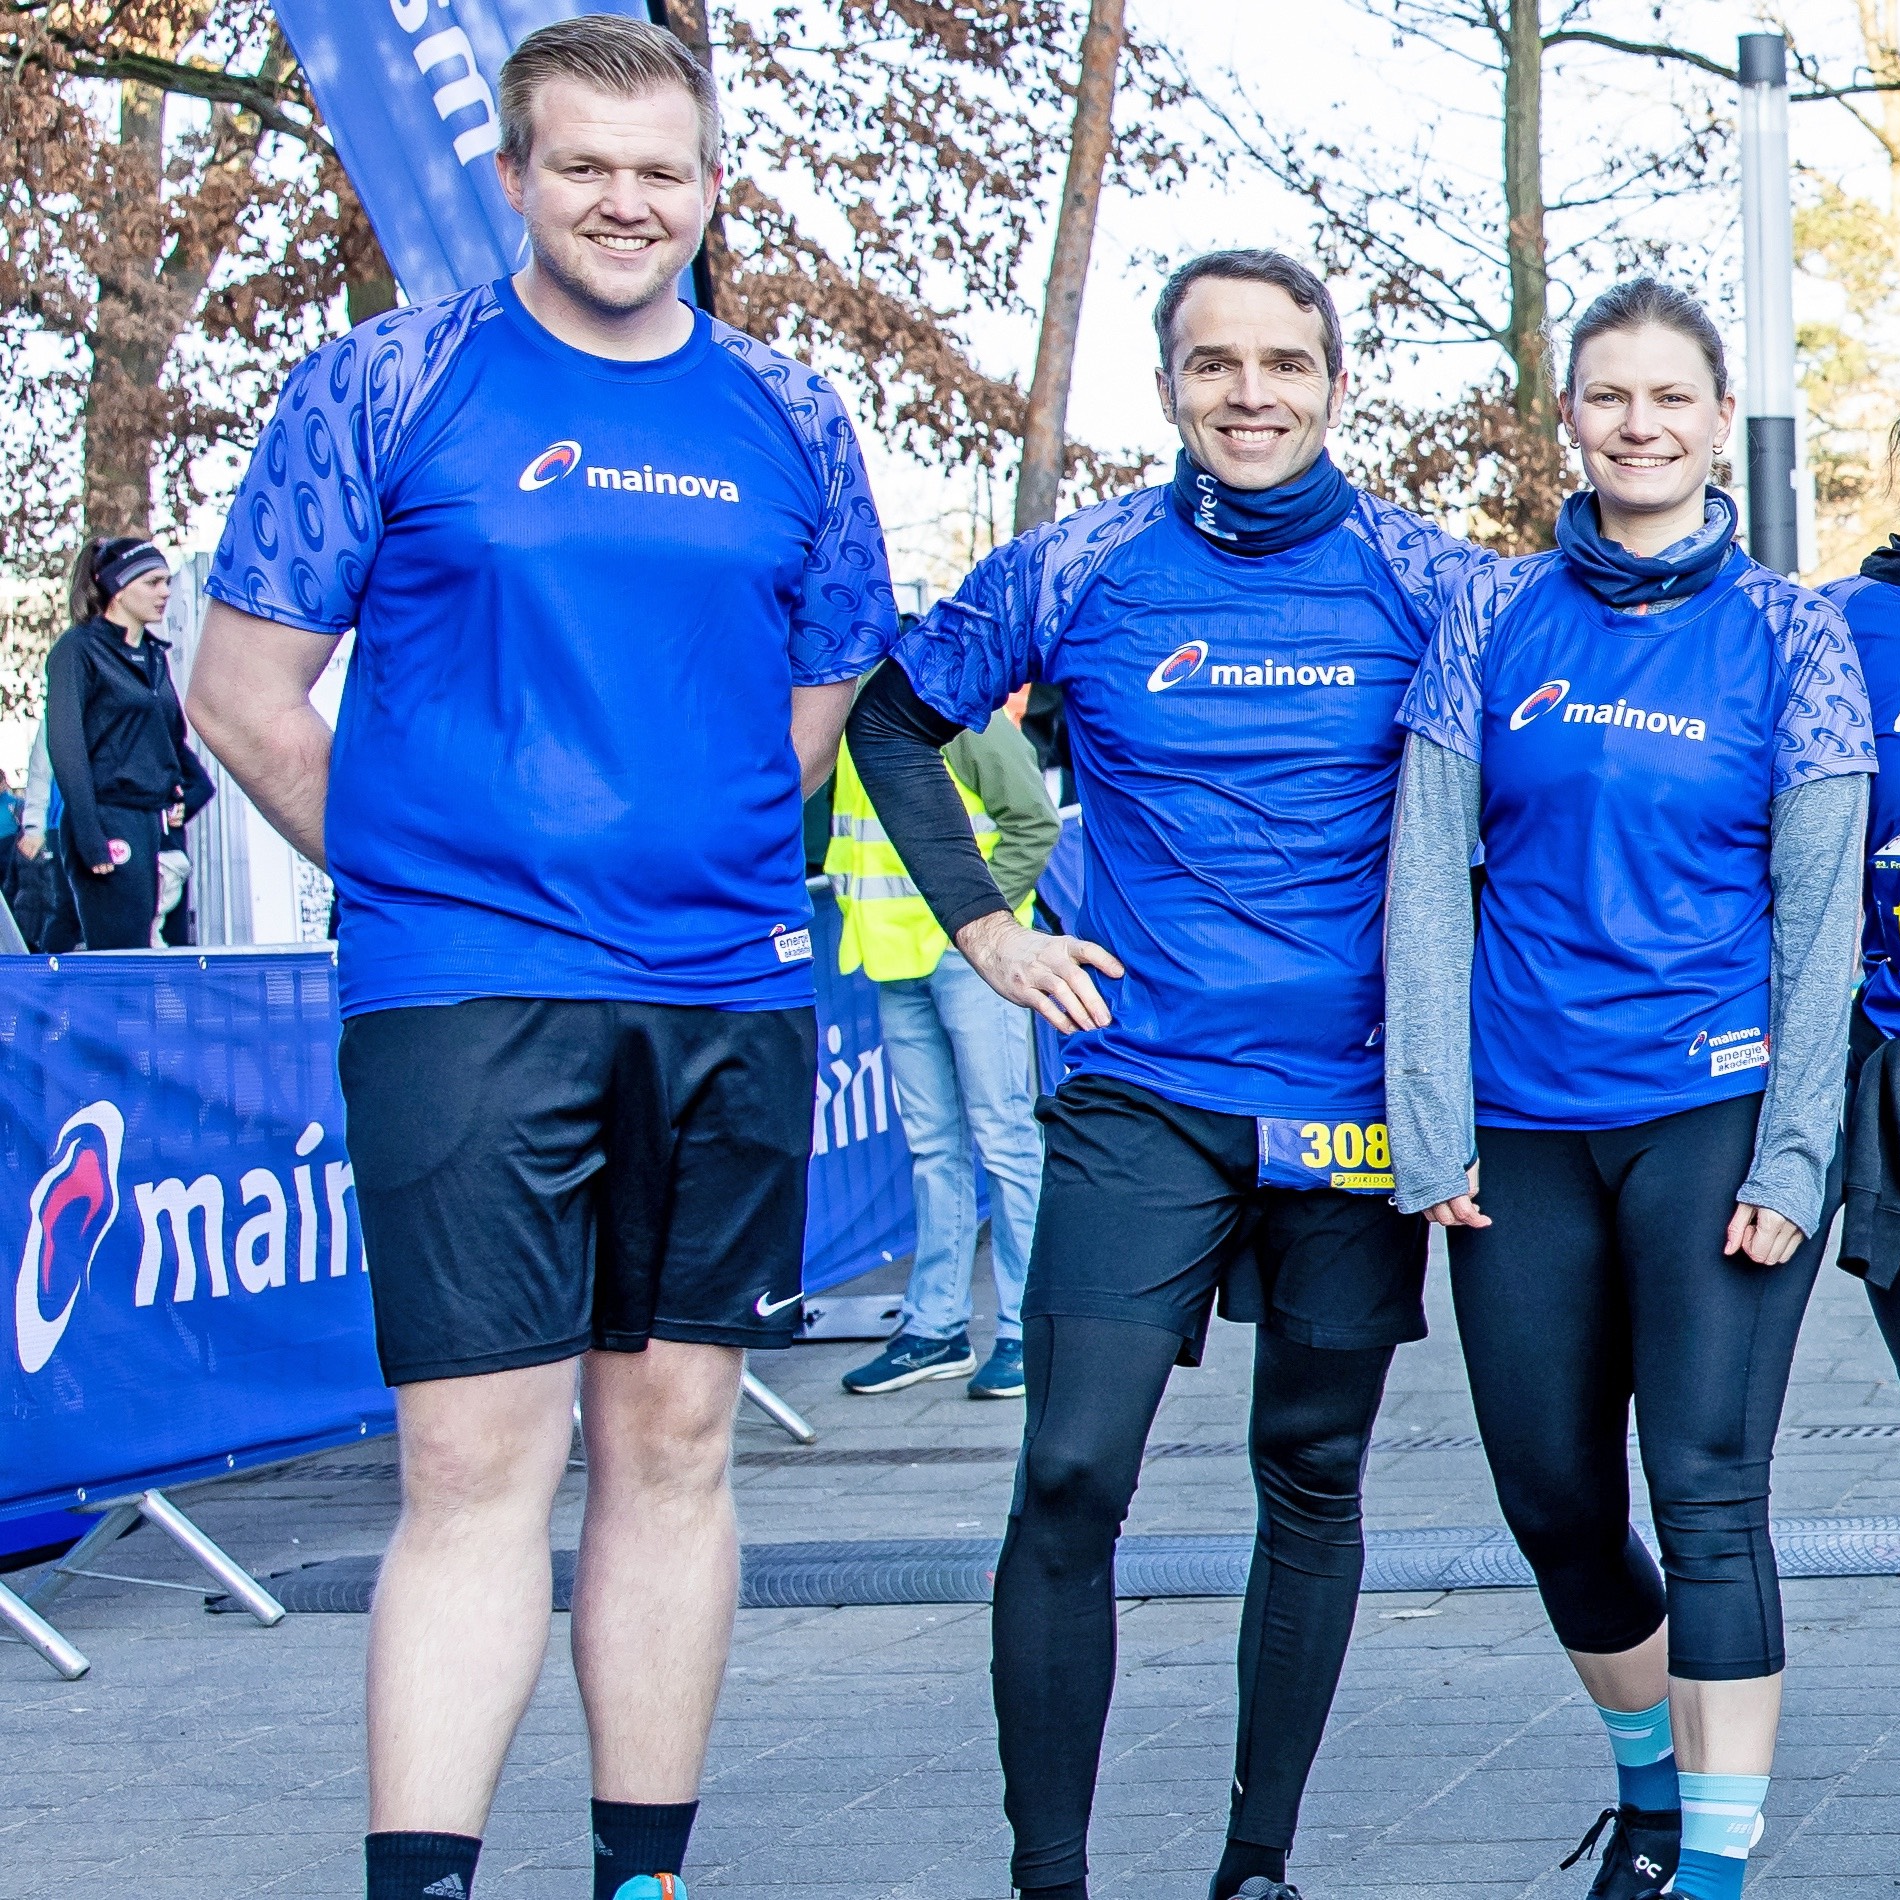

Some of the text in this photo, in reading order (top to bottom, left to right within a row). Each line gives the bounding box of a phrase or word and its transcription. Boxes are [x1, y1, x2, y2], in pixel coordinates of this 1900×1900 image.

[586, 464, 740, 503] mainova
[1210, 658, 1355, 686] mainova
[1562, 698, 1706, 741] mainova
[1708, 1027, 1761, 1047] mainova
[1716, 1045, 1762, 1063] energie
[1718, 1055, 1764, 1072] akademie
